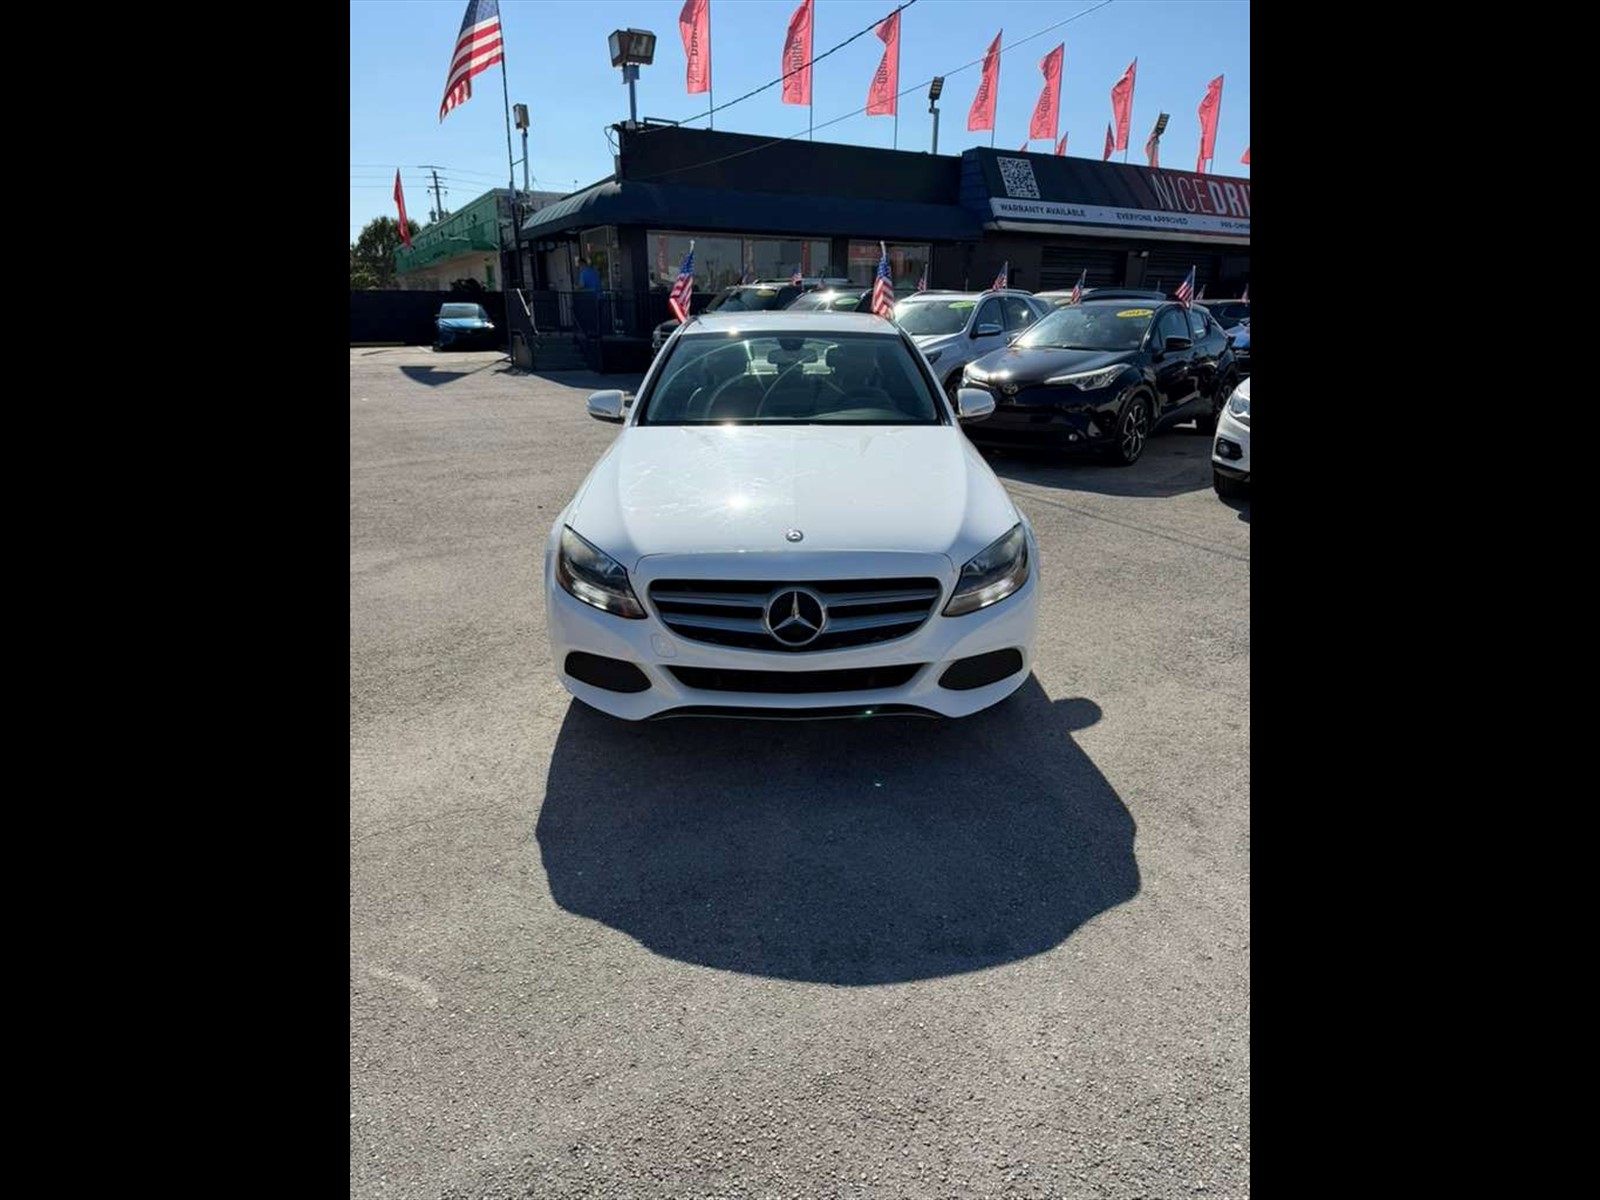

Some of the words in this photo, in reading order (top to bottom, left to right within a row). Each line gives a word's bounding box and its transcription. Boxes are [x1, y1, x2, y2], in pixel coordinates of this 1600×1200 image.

[1150, 174, 1250, 217] NICEDRI
[999, 203, 1044, 215] WARRANTY
[1045, 207, 1087, 218] AVAILABLE
[1115, 212, 1152, 222] EVERYONE
[1153, 215, 1189, 225] APPROVED
